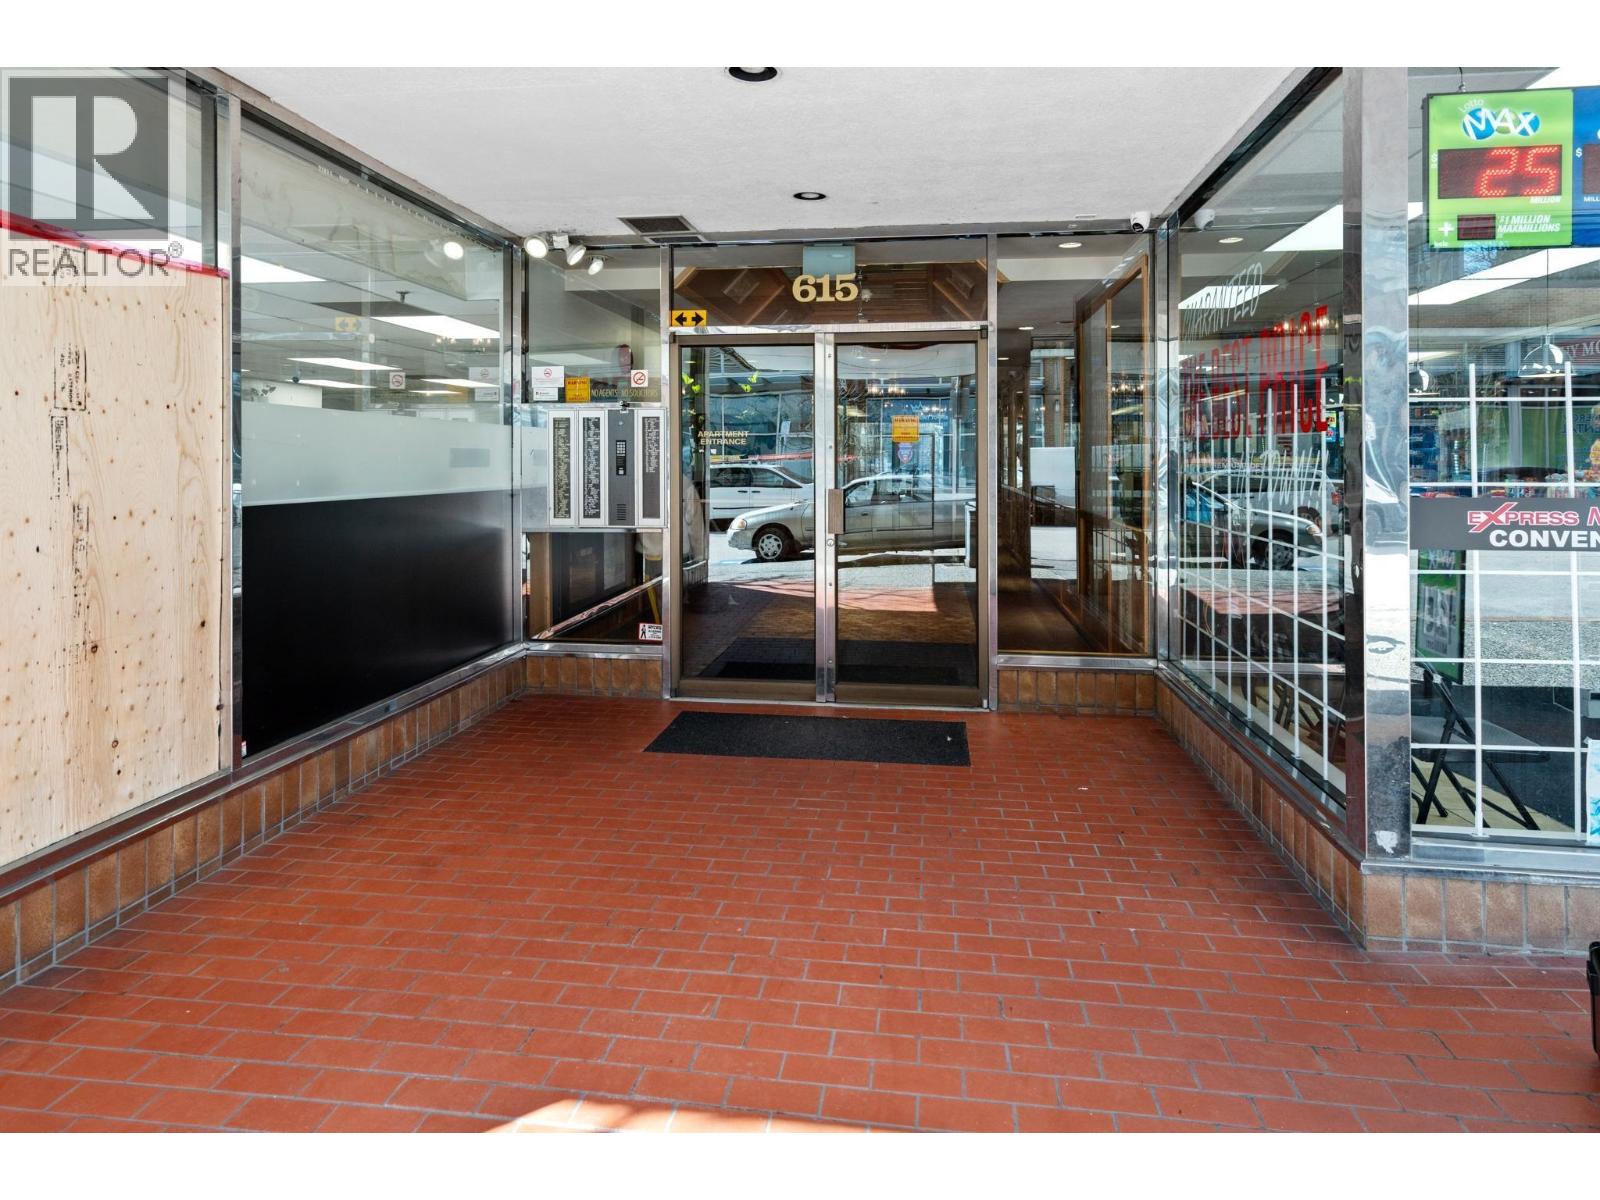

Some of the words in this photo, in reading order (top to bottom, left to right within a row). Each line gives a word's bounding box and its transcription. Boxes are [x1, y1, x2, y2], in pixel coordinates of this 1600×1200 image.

[1458, 99, 1485, 113] Lotto
[1463, 107, 1539, 140] MAX
[1478, 147, 1559, 196] 25
[1498, 223, 1561, 233] MAXMILLIONS
[1511, 214, 1552, 225] MILLION
[792, 273, 859, 303] 615
[1211, 337, 1252, 440] BEST
[1260, 304, 1329, 436] PRICE
[697, 430, 750, 438] APARTMENT
[700, 438, 748, 446] ENTRANCE
[1467, 502, 1580, 533] EXPRESS
